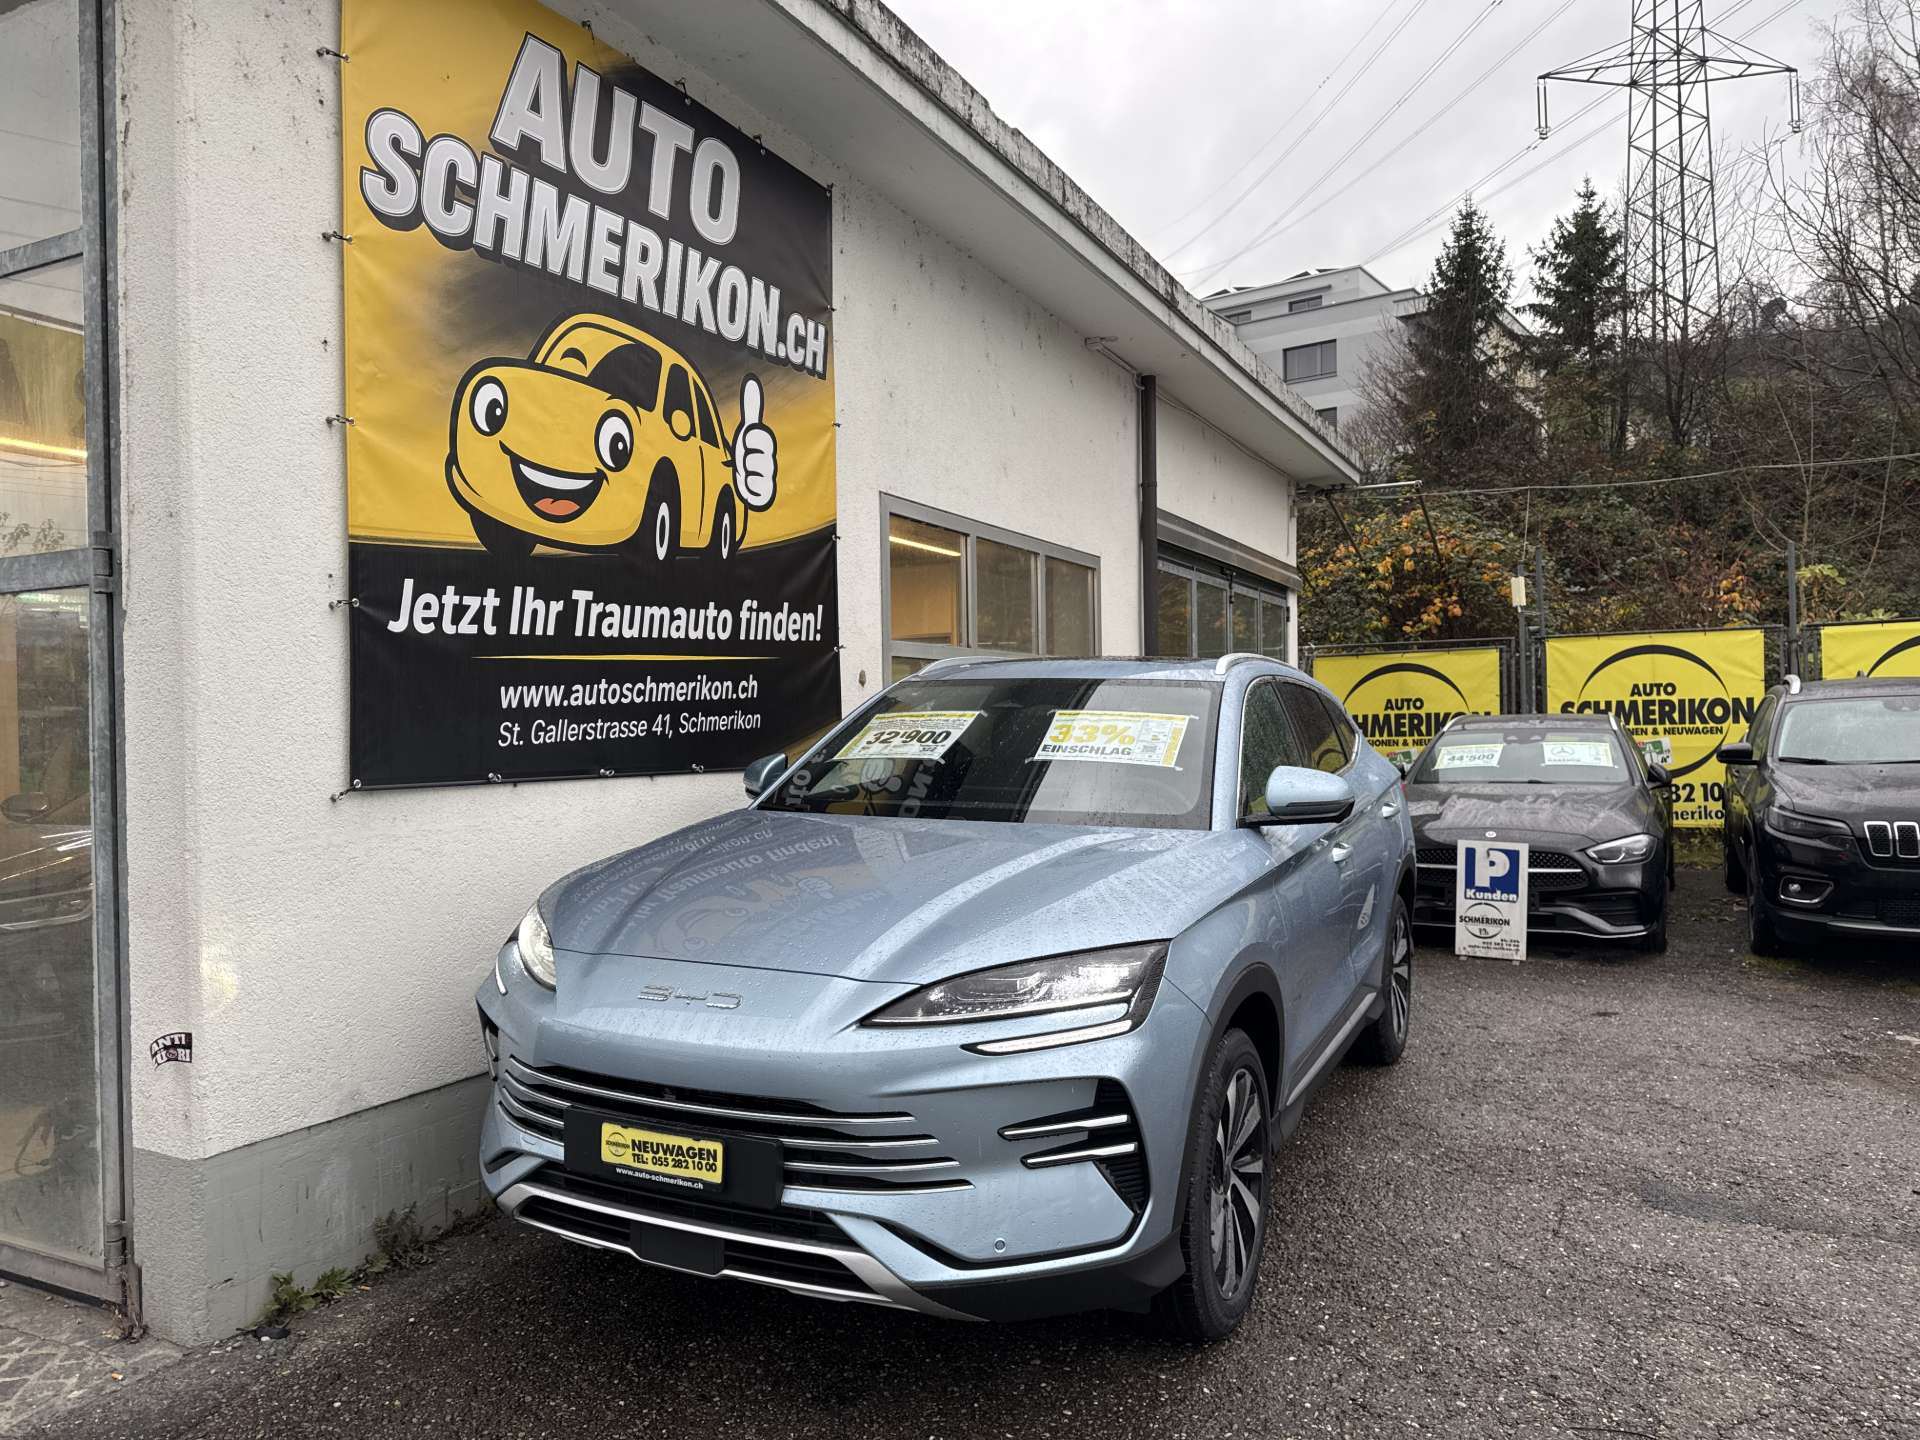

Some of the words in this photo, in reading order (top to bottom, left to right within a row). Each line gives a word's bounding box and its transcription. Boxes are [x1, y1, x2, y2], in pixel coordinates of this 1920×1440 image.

[492, 33, 742, 246] AUTO
[361, 109, 828, 374] SCHMERIKON.CH
[386, 577, 501, 636] Jetzt
[509, 585, 564, 636] Ihr
[571, 589, 733, 641] Traumauto
[739, 599, 824, 642] finden!
[500, 674, 758, 709] www.autoschmerikon.ch
[1629, 682, 1677, 697] AUTO
[1384, 697, 1425, 712] AUTO
[498, 722, 523, 748] St.
[530, 718, 648, 745] Gallerstrasse
[651, 713, 673, 740] 41,
[678, 710, 761, 735] Schmerikon
[1048, 723, 1136, 745] 33%
[1352, 711, 1491, 738] HMERIK
[1651, 727, 1660, 736] &
[1663, 726, 1723, 736] NEUWAGEN
[866, 729, 953, 746] 32'900
[1401, 738, 1410, 747] &
[1040, 743, 1132, 757] EINSCHLAG
[1474, 847, 1510, 887] P
[1465, 888, 1518, 902] Kunden
[1459, 915, 1510, 926] SCHMERIKON
[630, 1138, 718, 1163] NEUWAGEN
[631, 1152, 649, 1165] TEL:
[651, 1156, 669, 1168] 055
[671, 1157, 689, 1170] 282
[692, 1160, 704, 1172] 10
[704, 1161, 717, 1173] 00
[615, 1166, 704, 1190] www.auto-schmerikon.ch
